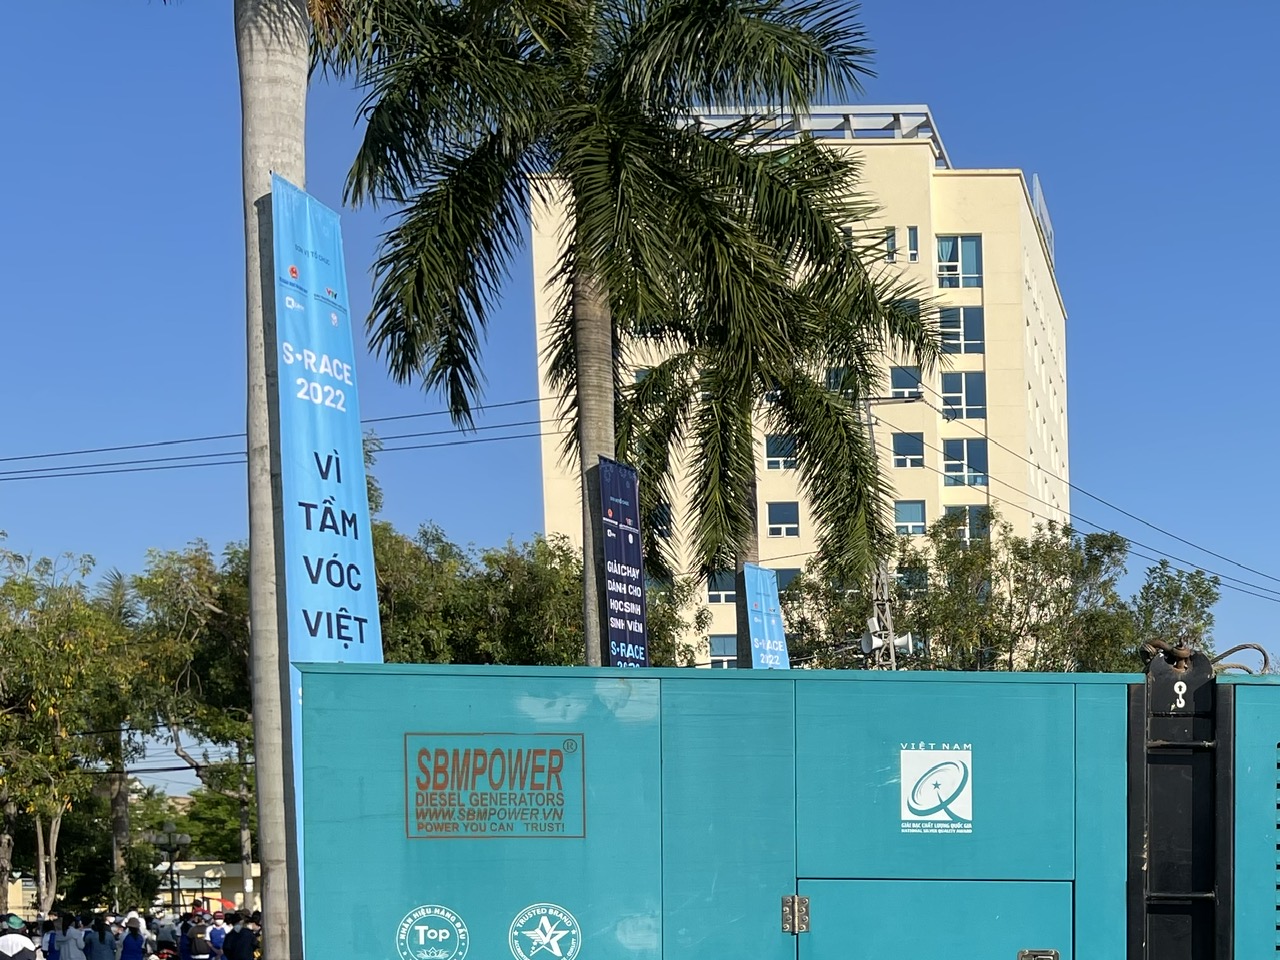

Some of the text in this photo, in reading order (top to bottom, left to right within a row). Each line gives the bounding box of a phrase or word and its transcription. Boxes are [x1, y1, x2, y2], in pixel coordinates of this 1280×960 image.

[296, 377, 346, 413] 2022
[314, 448, 342, 484] VÌ
[298, 495, 359, 541] TẦM
[302, 552, 362, 592] VÓC
[620, 565, 640, 581] CHẠY
[628, 584, 641, 598] CHO
[609, 598, 641, 616] HỌC SINH
[302, 607, 368, 650] VIỆT
[610, 616, 643, 634] SINH VIÊN
[900, 741, 936, 750] VIỆT
[415, 747, 564, 791] SBMPOWER
[415, 792, 565, 807] DIESEL GENERATORS
[415, 807, 564, 821] WWW.SBMPOWER.VN
[416, 822, 565, 833] POWER YOU CAN TRUST!
[516, 907, 573, 928] TRUSTED BRAND
[414, 925, 450, 945] Top
